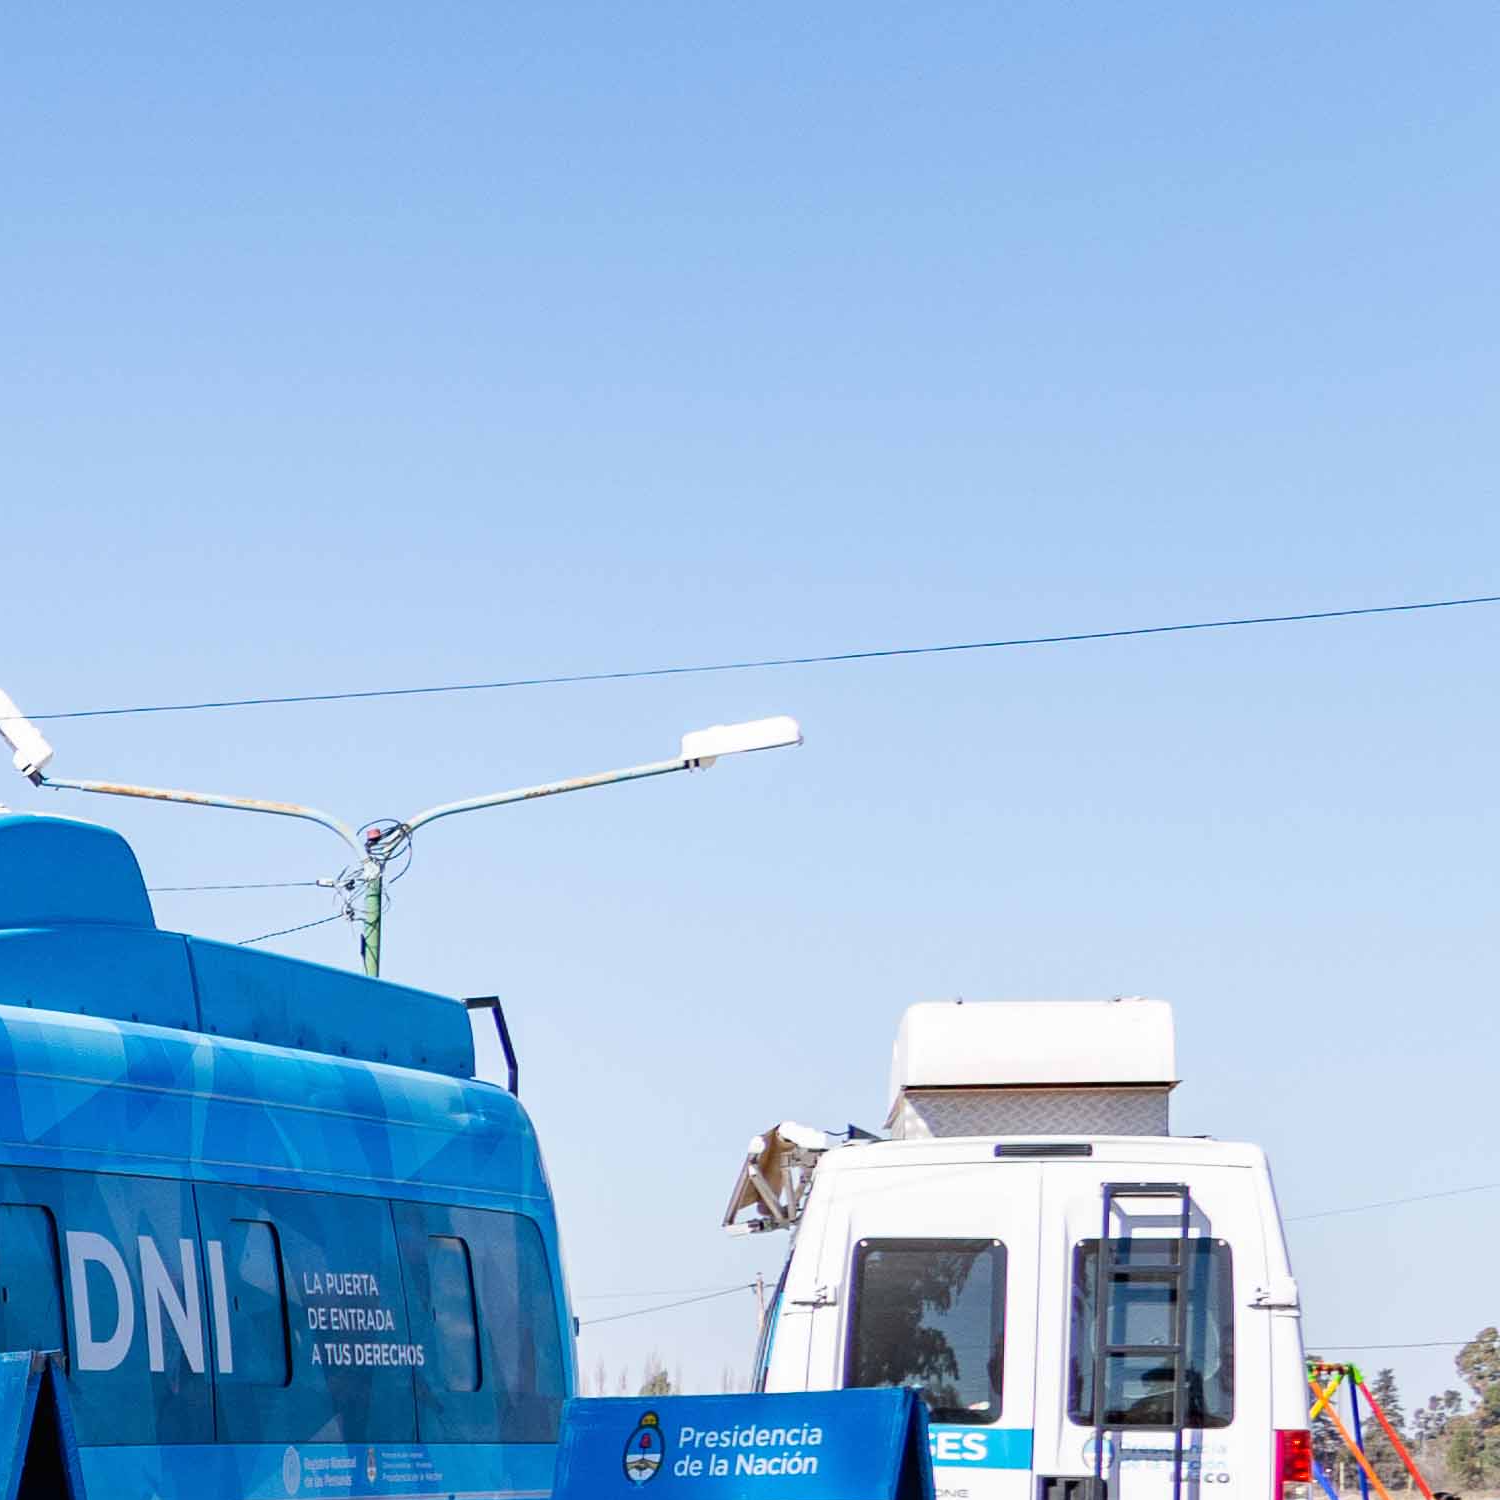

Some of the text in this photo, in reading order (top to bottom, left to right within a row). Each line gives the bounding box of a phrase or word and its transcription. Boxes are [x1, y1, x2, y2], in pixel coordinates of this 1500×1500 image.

[304, 1272, 379, 1296] LA PUERTA
[66, 1231, 233, 1374] DNI
[308, 1308, 395, 1331] DE ENTRADA
[312, 1344, 424, 1366] A TUS DERECHOS
[679, 1423, 822, 1448] Presidencia
[674, 1451, 818, 1476] de la Nación
